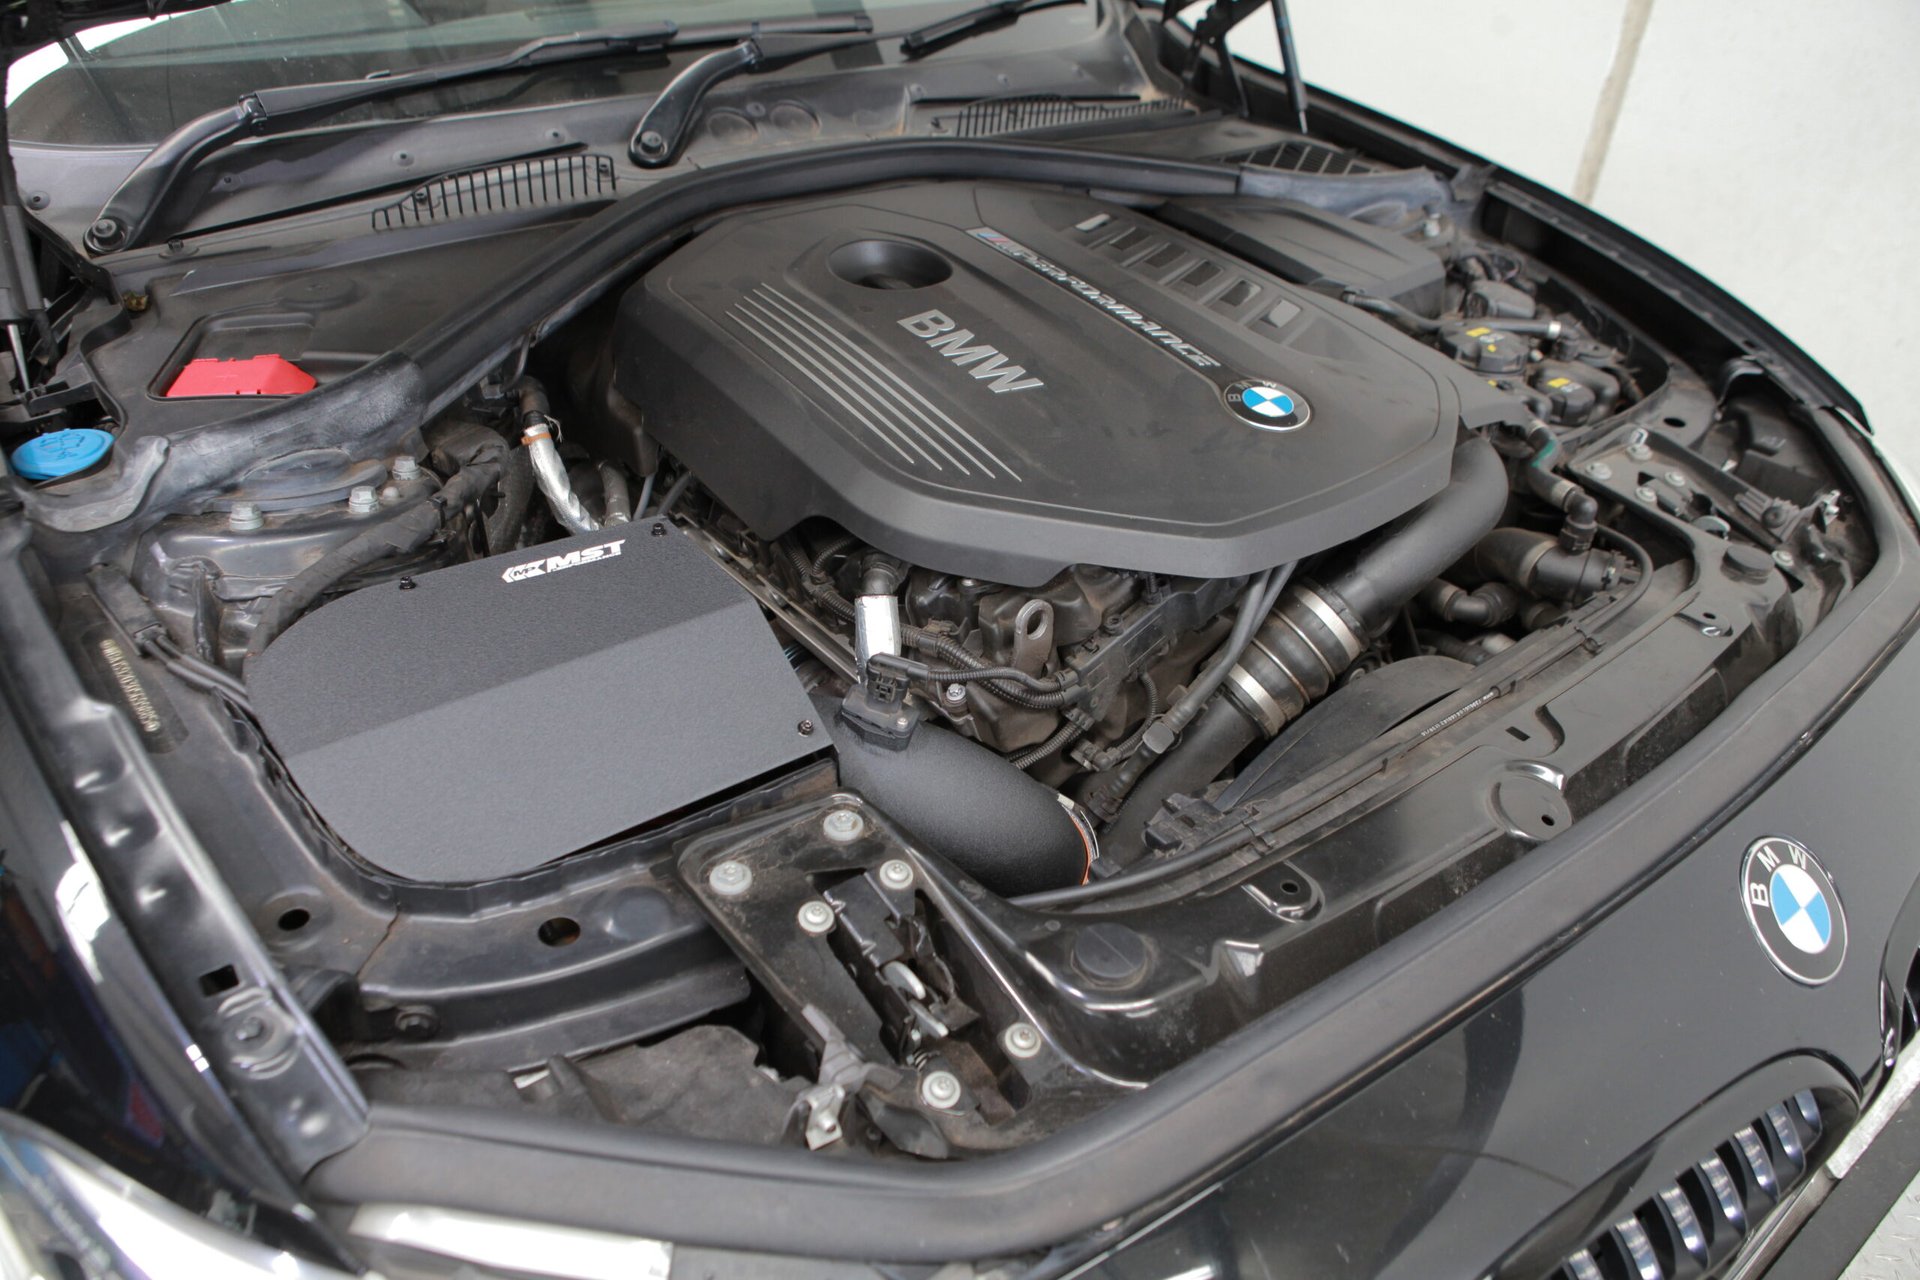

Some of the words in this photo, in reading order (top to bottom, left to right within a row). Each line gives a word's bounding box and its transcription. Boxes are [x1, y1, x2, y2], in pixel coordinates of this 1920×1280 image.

[1012, 247, 1221, 367] PERFORMANCE
[897, 309, 1044, 393] BMW
[1227, 381, 1277, 402] BMW
[547, 539, 626, 573] MST
[1750, 845, 1807, 908] BMW
